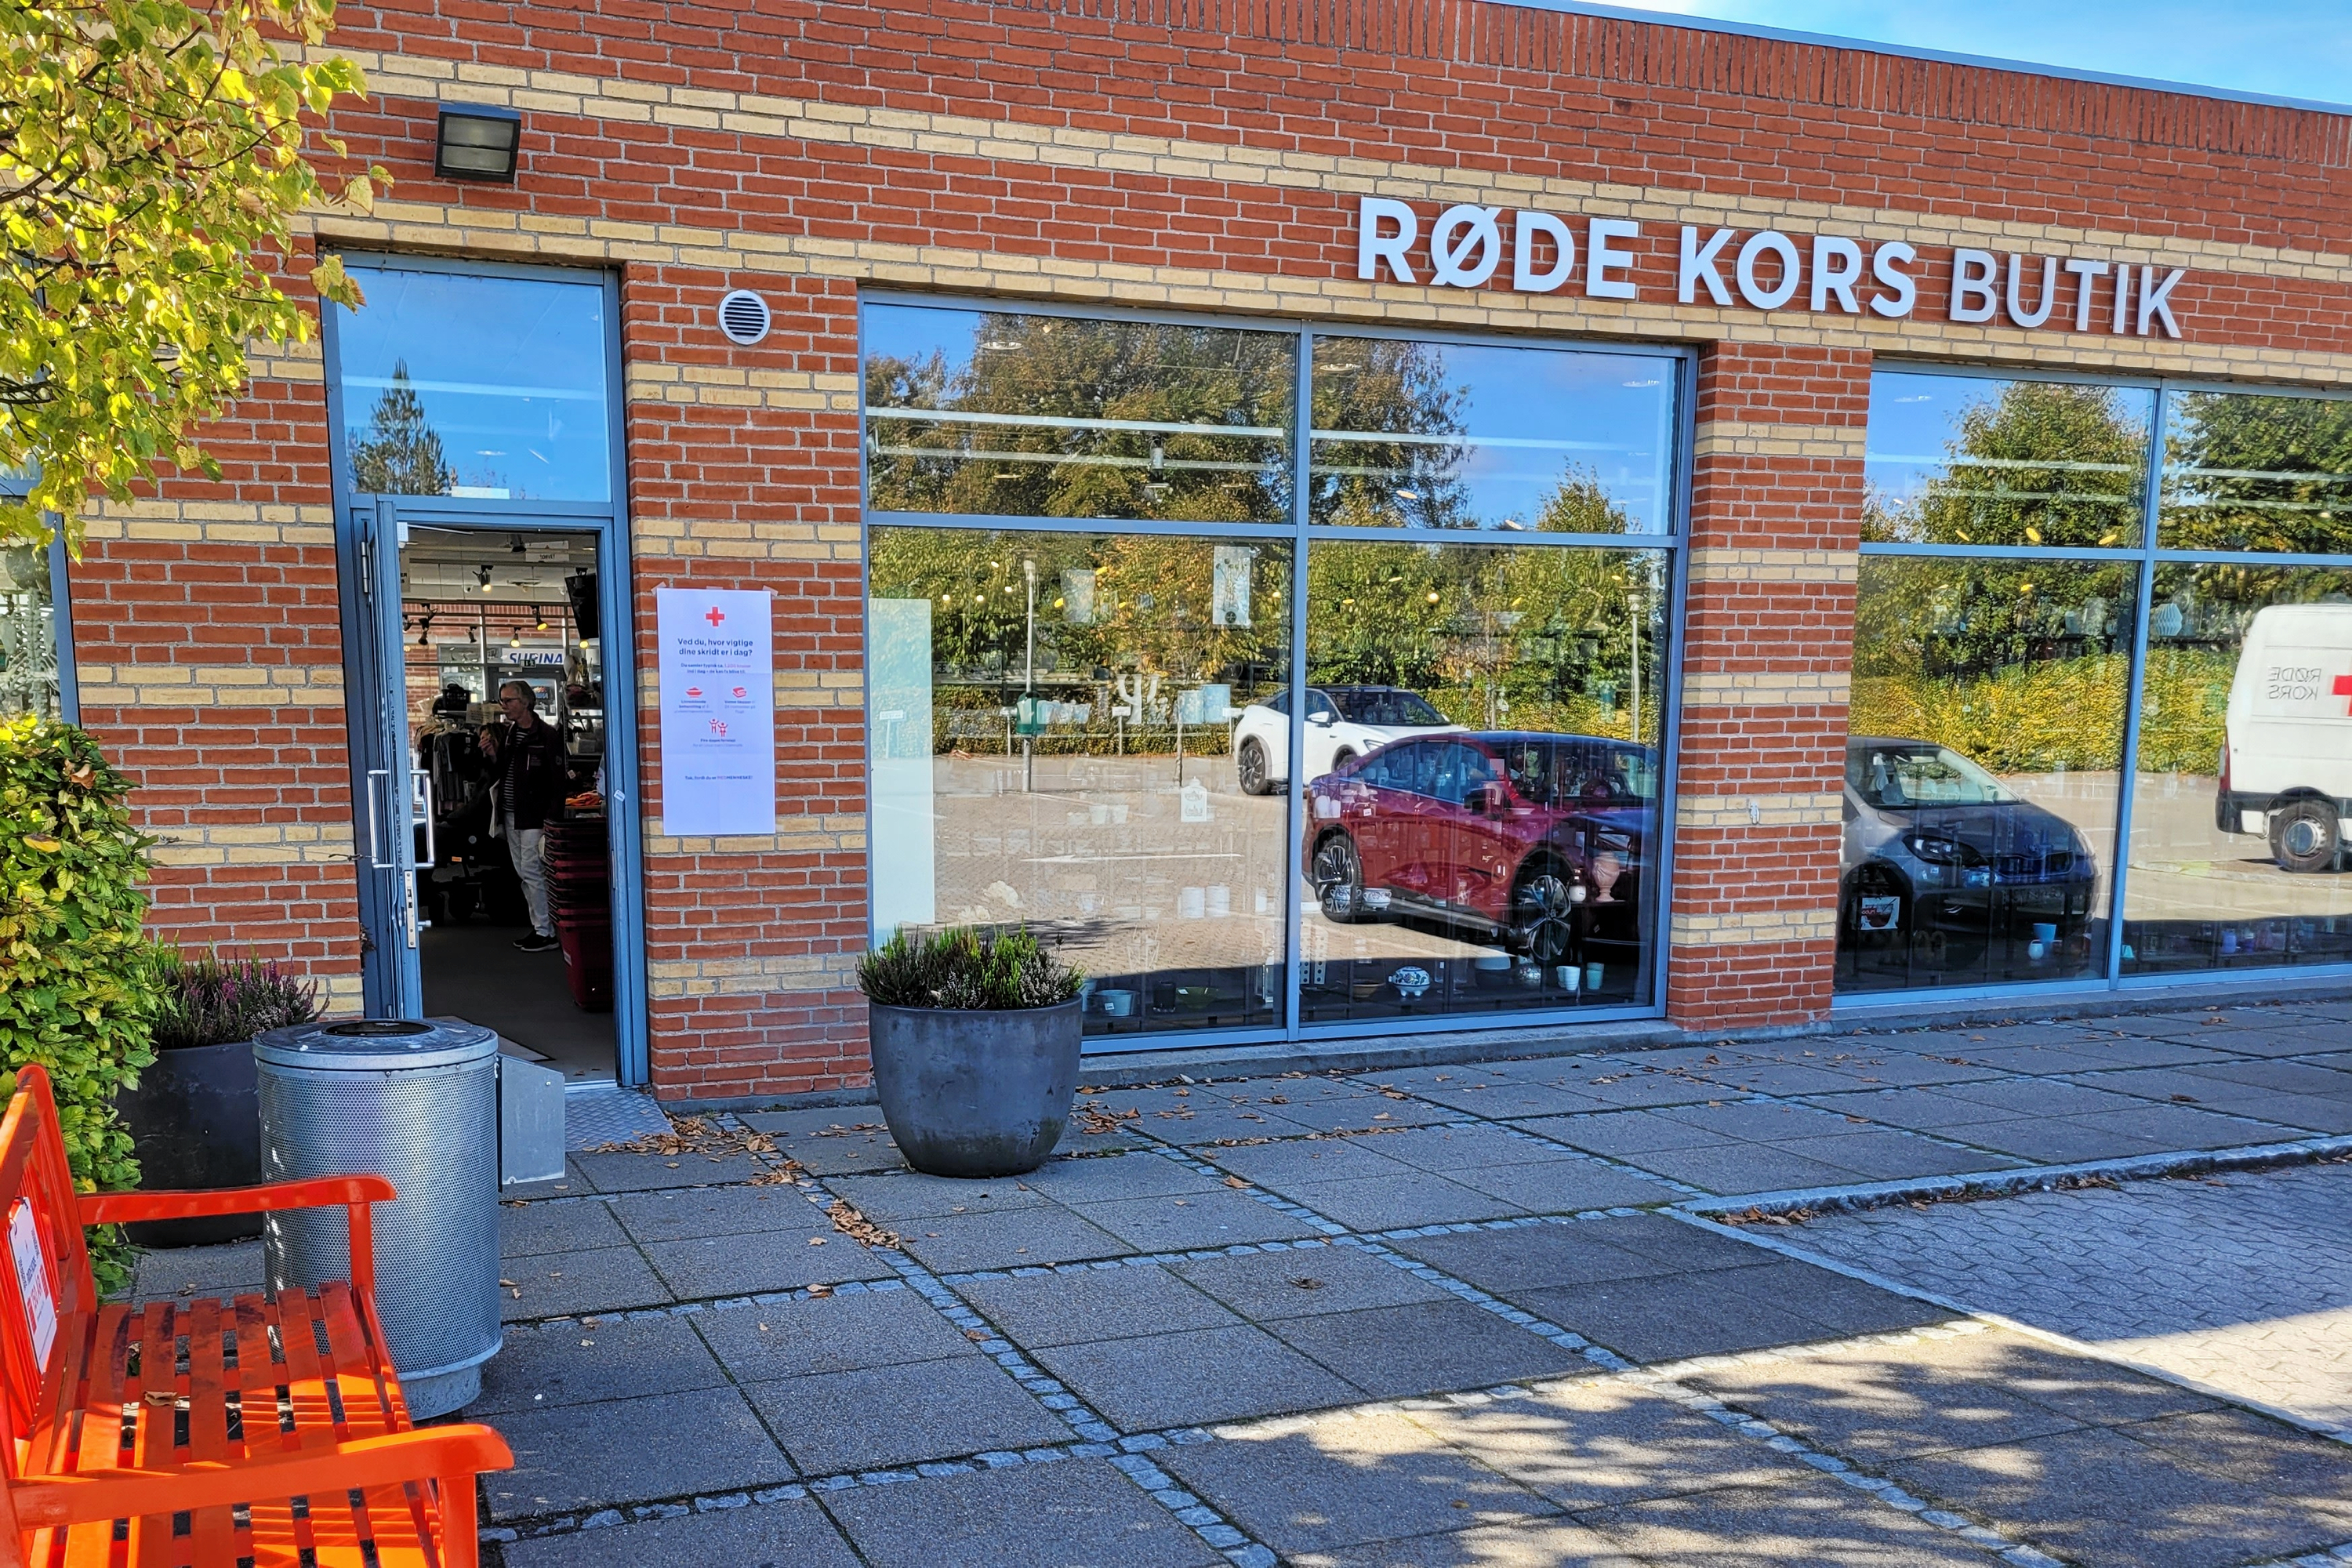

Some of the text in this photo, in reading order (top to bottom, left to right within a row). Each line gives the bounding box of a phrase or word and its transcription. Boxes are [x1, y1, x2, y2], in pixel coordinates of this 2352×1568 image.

[1357, 197, 2187, 339] RØDE KORS BUTIK
